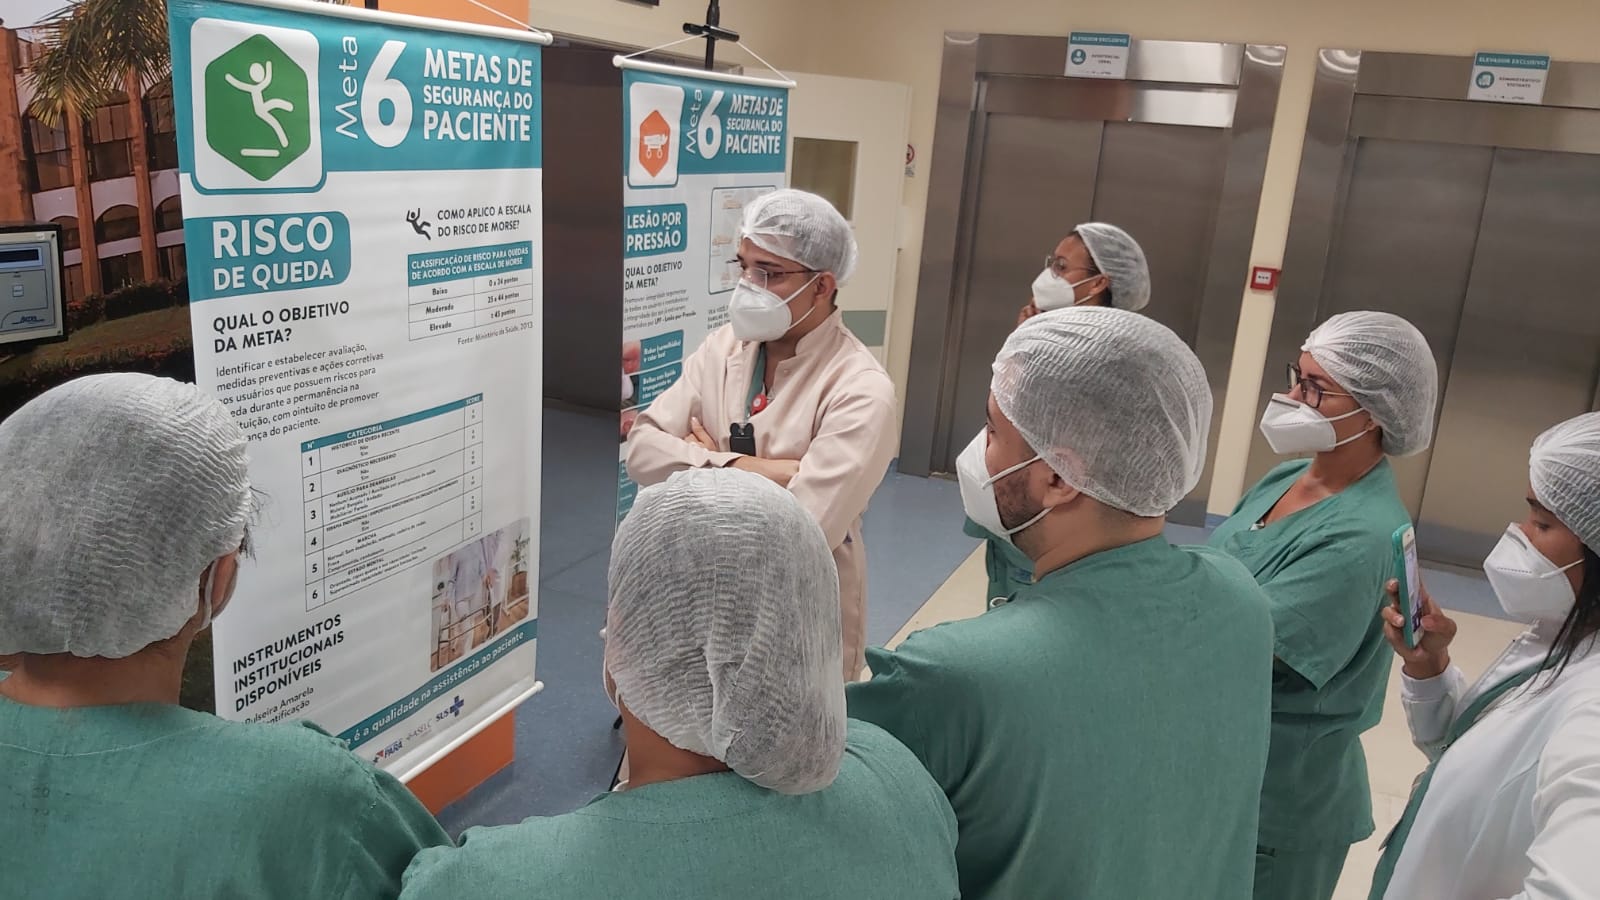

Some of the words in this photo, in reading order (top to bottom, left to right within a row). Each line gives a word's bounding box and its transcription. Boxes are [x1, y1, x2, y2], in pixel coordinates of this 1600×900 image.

[423, 47, 501, 84] METAS
[507, 57, 533, 87] DE
[335, 36, 359, 140] Meta
[361, 40, 413, 148] 6
[423, 85, 511, 112] SEGURANÇA
[514, 91, 533, 110] DO
[729, 93, 769, 116] METAS
[768, 97, 783, 117] DE
[423, 109, 531, 141] PACIENTE
[685, 89, 703, 154] Meta
[697, 89, 724, 159] 6
[726, 117, 770, 134] SEGURANÇA
[771, 120, 783, 132] DO
[724, 133, 781, 154] PACIENTE
[437, 209, 466, 221] COMO
[467, 206, 496, 219] APLICO
[498, 206, 503, 216] A
[506, 204, 532, 216] ESCALA
[627, 210, 660, 229] LESÃO
[662, 212, 682, 226] POR
[212, 215, 334, 259] RISCO
[438, 226, 451, 238] DO
[453, 224, 477, 236] RISCO
[478, 222, 489, 233] DE
[491, 219, 520, 232] MORSE?
[626, 226, 682, 252] PRESSÃO
[411, 253, 462, 270] CLASSIFICAÇÃO
[464, 254, 472, 264] DE
[473, 252, 492, 262] RISCO
[492, 250, 506, 260] PARA
[508, 246, 529, 258] QUEDAS
[411, 271, 422, 281] DE
[422, 267, 450, 280] ACORDO
[452, 265, 468, 274] COM
[468, 264, 472, 272] A
[473, 262, 497, 272] ESCALA
[498, 260, 504, 269] DE
[506, 257, 523, 268] MORSE
[625, 266, 645, 278] QUAL
[647, 266, 652, 274] O
[653, 260, 682, 274] OBJETIVO
[213, 266, 245, 291] DE
[252, 258, 334, 290] QUEDA
[625, 280, 634, 290] DA
[636, 277, 658, 289] META?
[432, 287, 448, 296] Baixo
[213, 312, 258, 335] QUAL
[262, 310, 274, 325] O
[278, 300, 350, 323] OBJETIVO
[425, 304, 454, 315] Moderado
[429, 321, 452, 332] Elevado
[214, 336, 238, 354] DA
[242, 328, 292, 349] META?
[216, 360, 266, 378] Identificar
[267, 360, 273, 368] e
[274, 350, 326, 366] estabelecer
[328, 343, 368, 357] avaliação,
[216, 376, 257, 392] medidas
[258, 366, 310, 386] preventivas
[312, 366, 318, 374] e
[319, 359, 344, 373] ações
[345, 352, 384, 368] corretivas
[236, 386, 274, 404] usuários
[276, 384, 292, 396] que
[293, 376, 332, 394] possuem
[333, 370, 358, 382] riscos
[359, 367, 376, 382] para
[249, 398, 285, 414] durante
[286, 397, 292, 405] a
[293, 384, 348, 406] permanência
[350, 382, 360, 392] na
[272, 412, 291, 422] com
[292, 402, 326, 418] ointuito
[328, 398, 338, 410] de
[339, 390, 380, 408] promover
[270, 426, 280, 436] do
[282, 416, 321, 434] paciente.
[346, 424, 383, 439] CATEGORIA
[308, 456, 313, 466] 1
[310, 483, 315, 492] 2
[310, 510, 316, 520] 3
[311, 537, 317, 546] 4
[312, 563, 318, 574] 5
[312, 590, 318, 600] 6
[233, 614, 342, 675] INSTRUMENTOS
[234, 630, 344, 694] INSTITUCIONAIS
[235, 658, 322, 712] DISPONÍVEIS
[354, 730, 360, 742] é
[363, 727, 370, 736] a
[372, 696, 420, 732] qualidade
[421, 688, 431, 702] na
[432, 658, 480, 692] assistência
[481, 652, 491, 664] ao
[492, 630, 524, 662] paciente
[280, 686, 314, 710] Amarela
[435, 708, 450, 722] SUS
